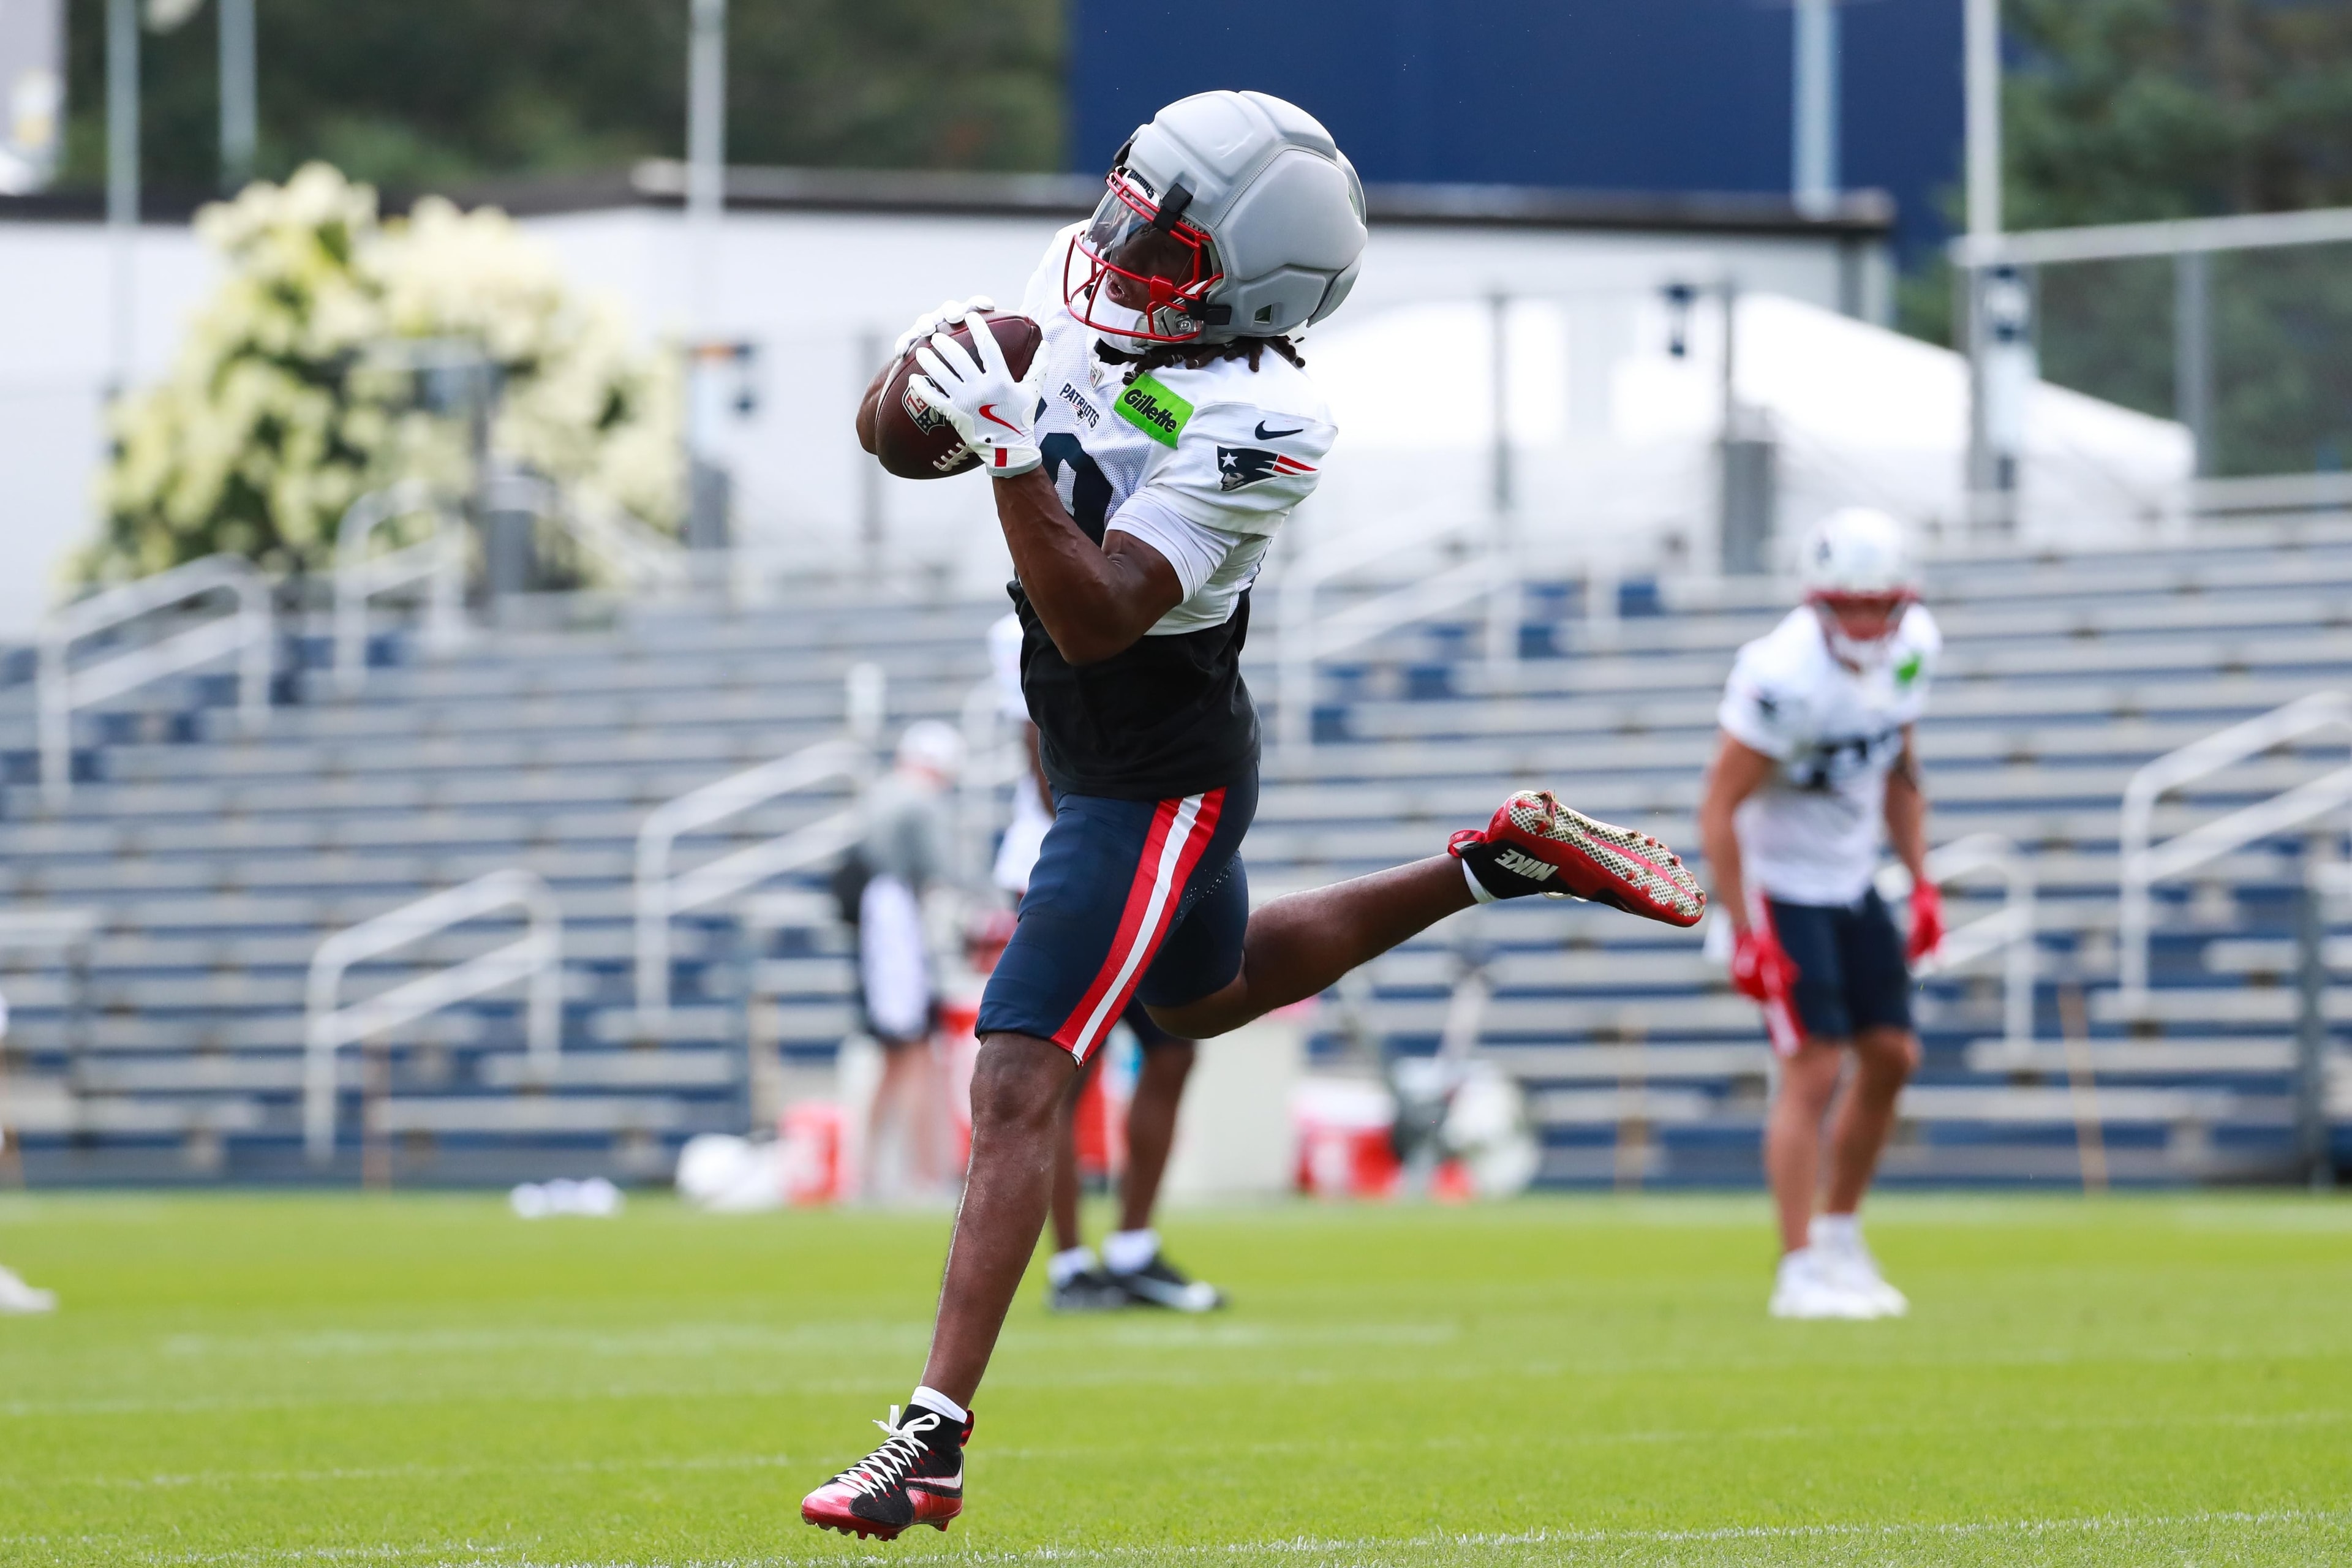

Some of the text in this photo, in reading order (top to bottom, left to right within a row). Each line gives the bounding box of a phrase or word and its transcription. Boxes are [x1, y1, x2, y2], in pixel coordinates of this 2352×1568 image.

[1127, 169, 1155, 200] PATRIOTS
[1059, 382, 1100, 429] PATRIOTS
[1123, 389, 1178, 433] Gillette
[1494, 848, 1559, 882] NIKE
